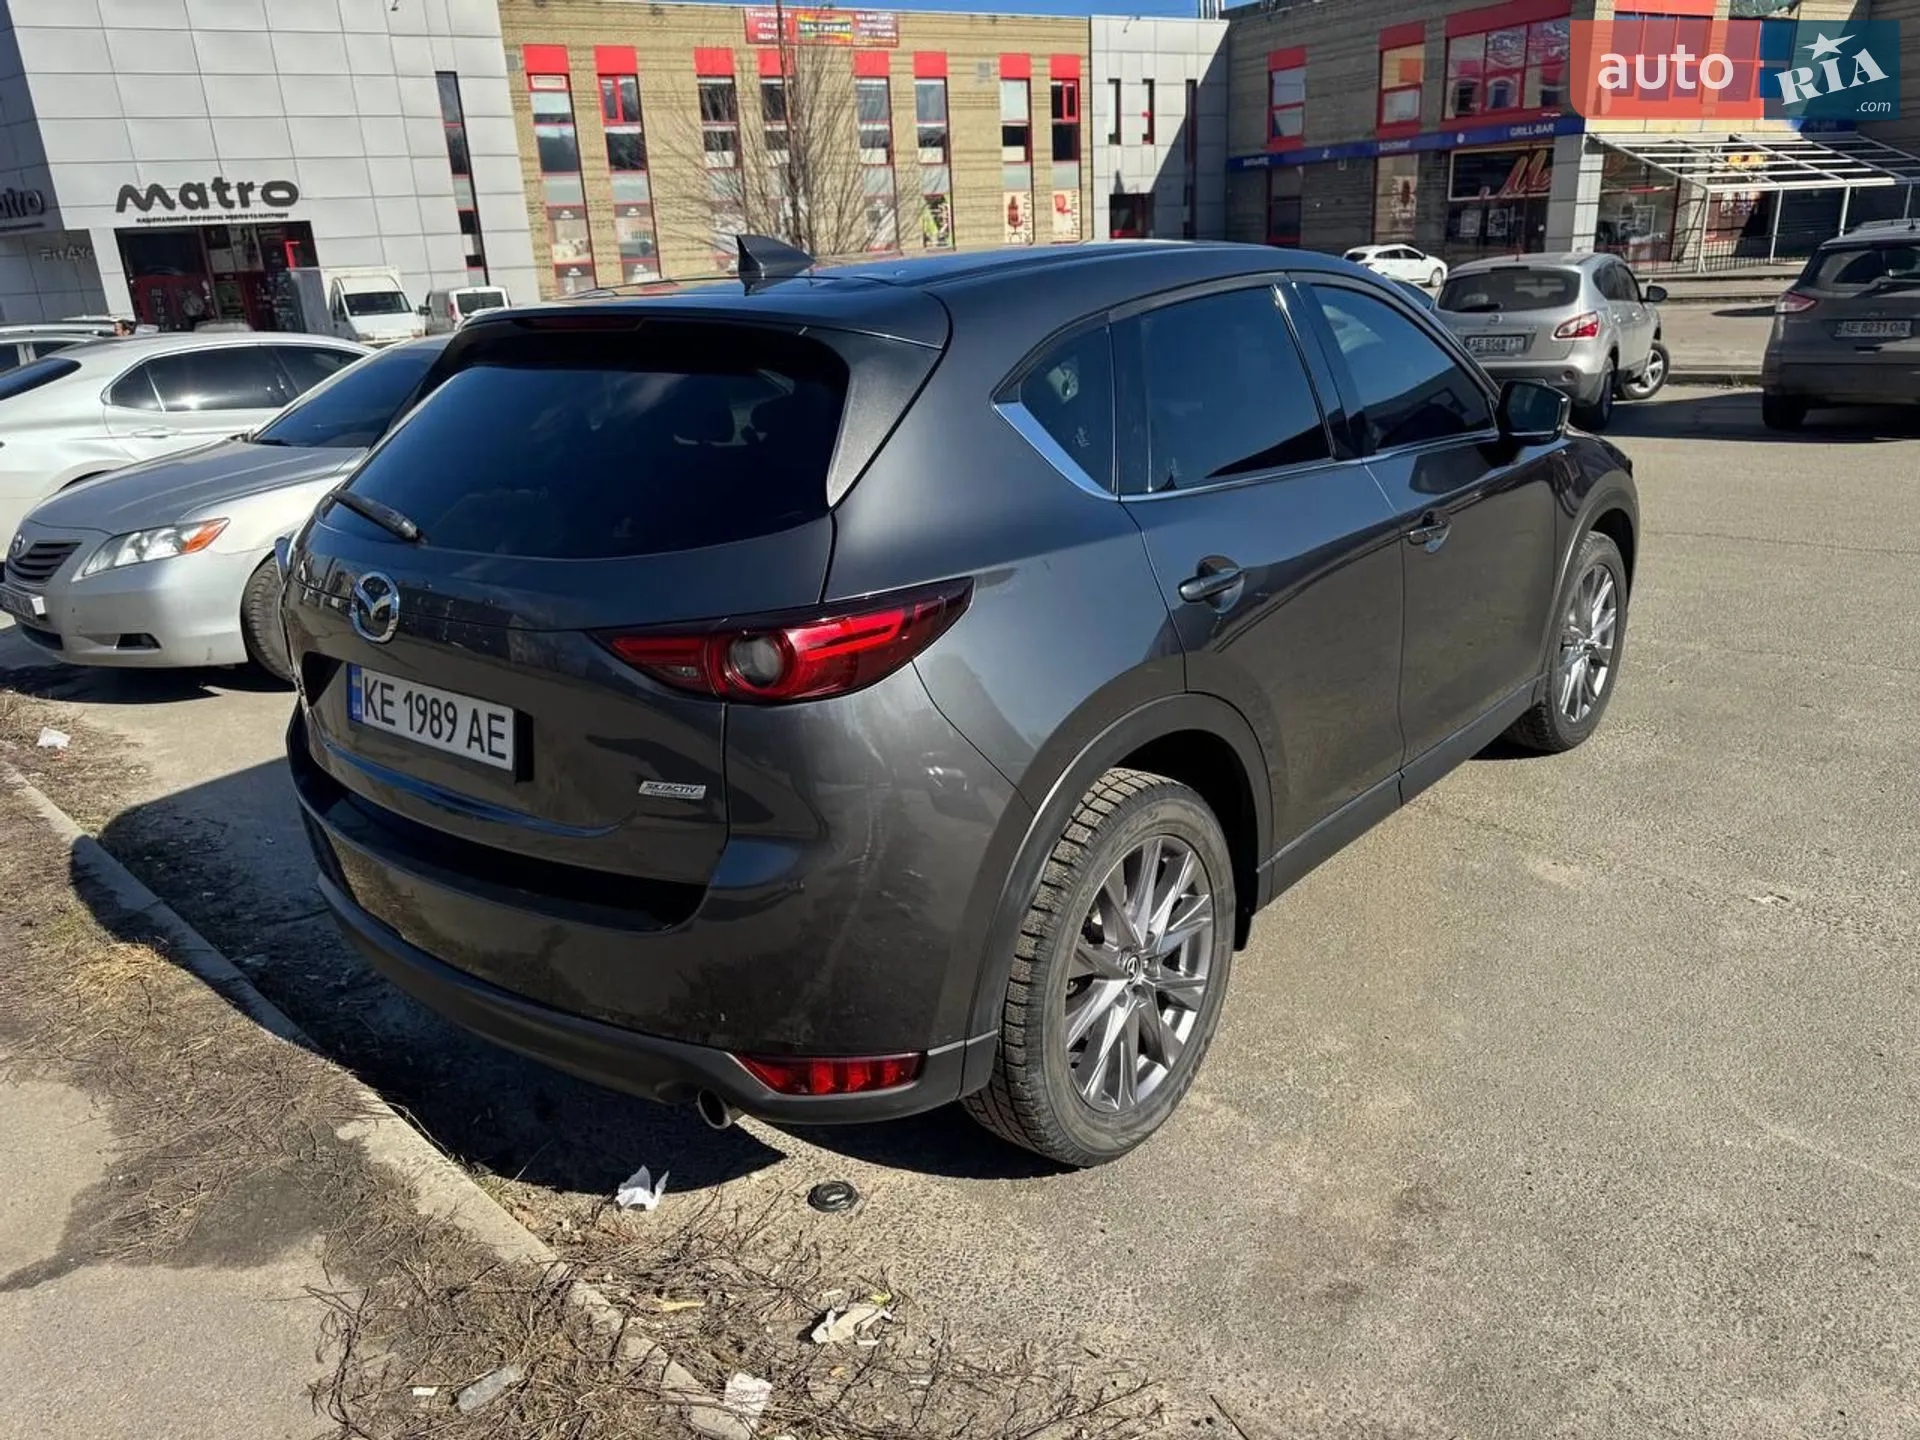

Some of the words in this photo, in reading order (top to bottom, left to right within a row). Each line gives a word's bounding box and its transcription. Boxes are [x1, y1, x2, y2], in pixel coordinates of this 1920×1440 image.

[364, 676, 396, 726] KE
[403, 690, 457, 743] 1989
[466, 708, 506, 760] AE
